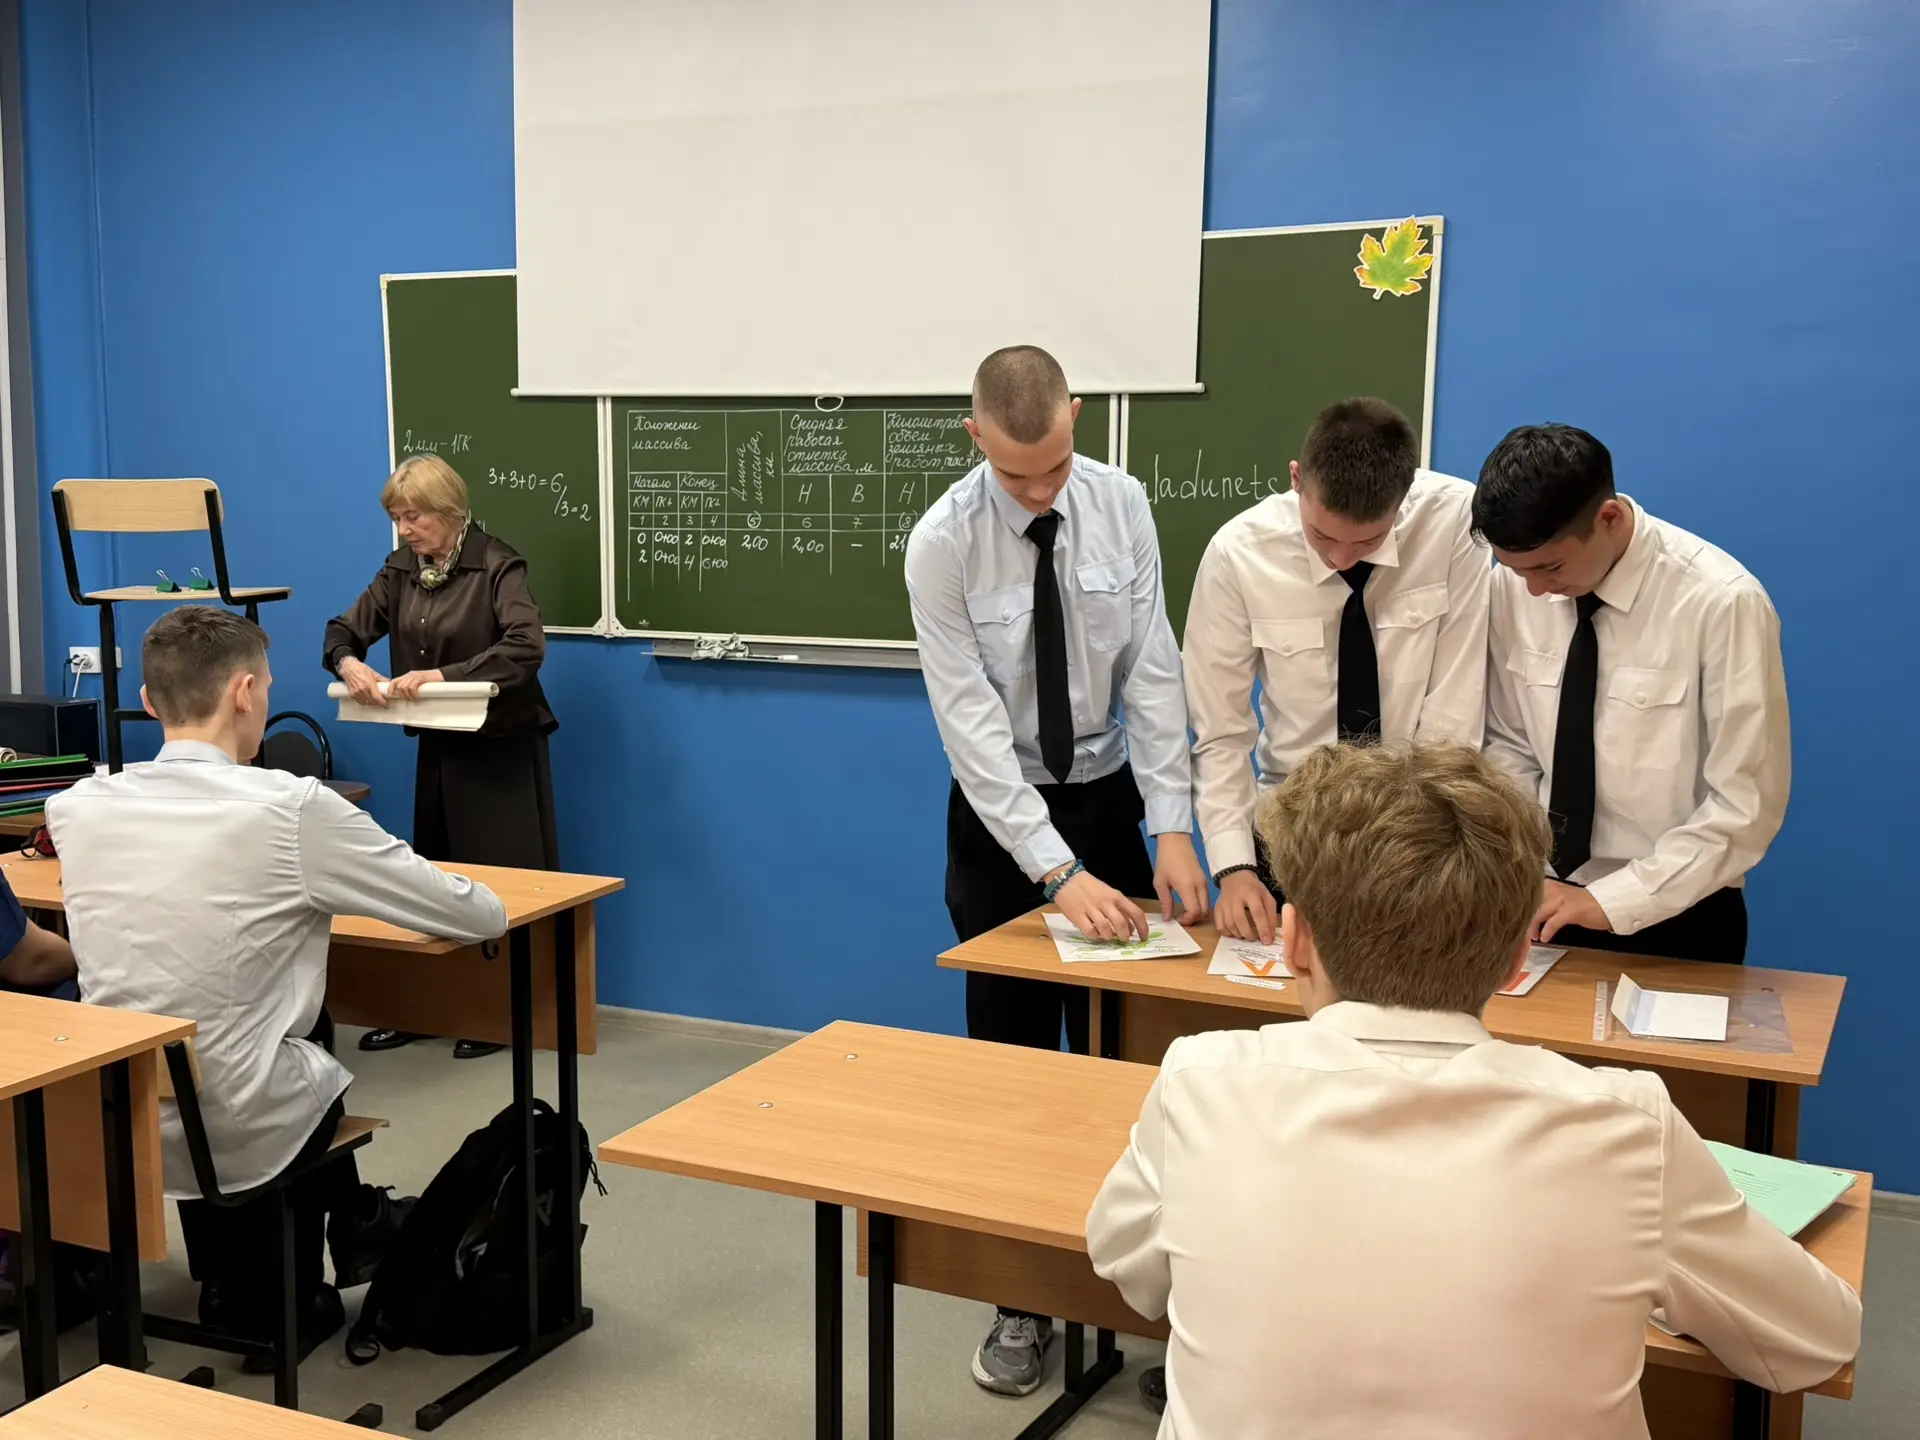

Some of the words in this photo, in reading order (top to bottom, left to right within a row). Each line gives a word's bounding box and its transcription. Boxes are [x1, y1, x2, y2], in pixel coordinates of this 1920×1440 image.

[886, 412, 965, 439] Километров
[632, 436, 692, 450] массива
[783, 431, 843, 456] рабочая
[787, 449, 848, 462] отметка
[765, 451, 775, 478] км
[633, 475, 672, 489] Начало
[680, 474, 720, 490] Конец
[799, 482, 813, 505] Н
[851, 483, 865, 503] В
[899, 481, 915, 505] Н
[633, 495, 650, 508] КМ
[680, 495, 698, 508] КМ
[640, 515, 645, 526] 1
[662, 515, 669, 526] 2
[686, 515, 694, 526] 3
[711, 515, 718, 527] 4
[802, 517, 812, 528] 6
[852, 517, 863, 529] 7
[637, 532, 646, 544] 0
[684, 534, 694, 546] 2
[639, 549, 648, 563] 2
[684, 554, 695, 571] 4
